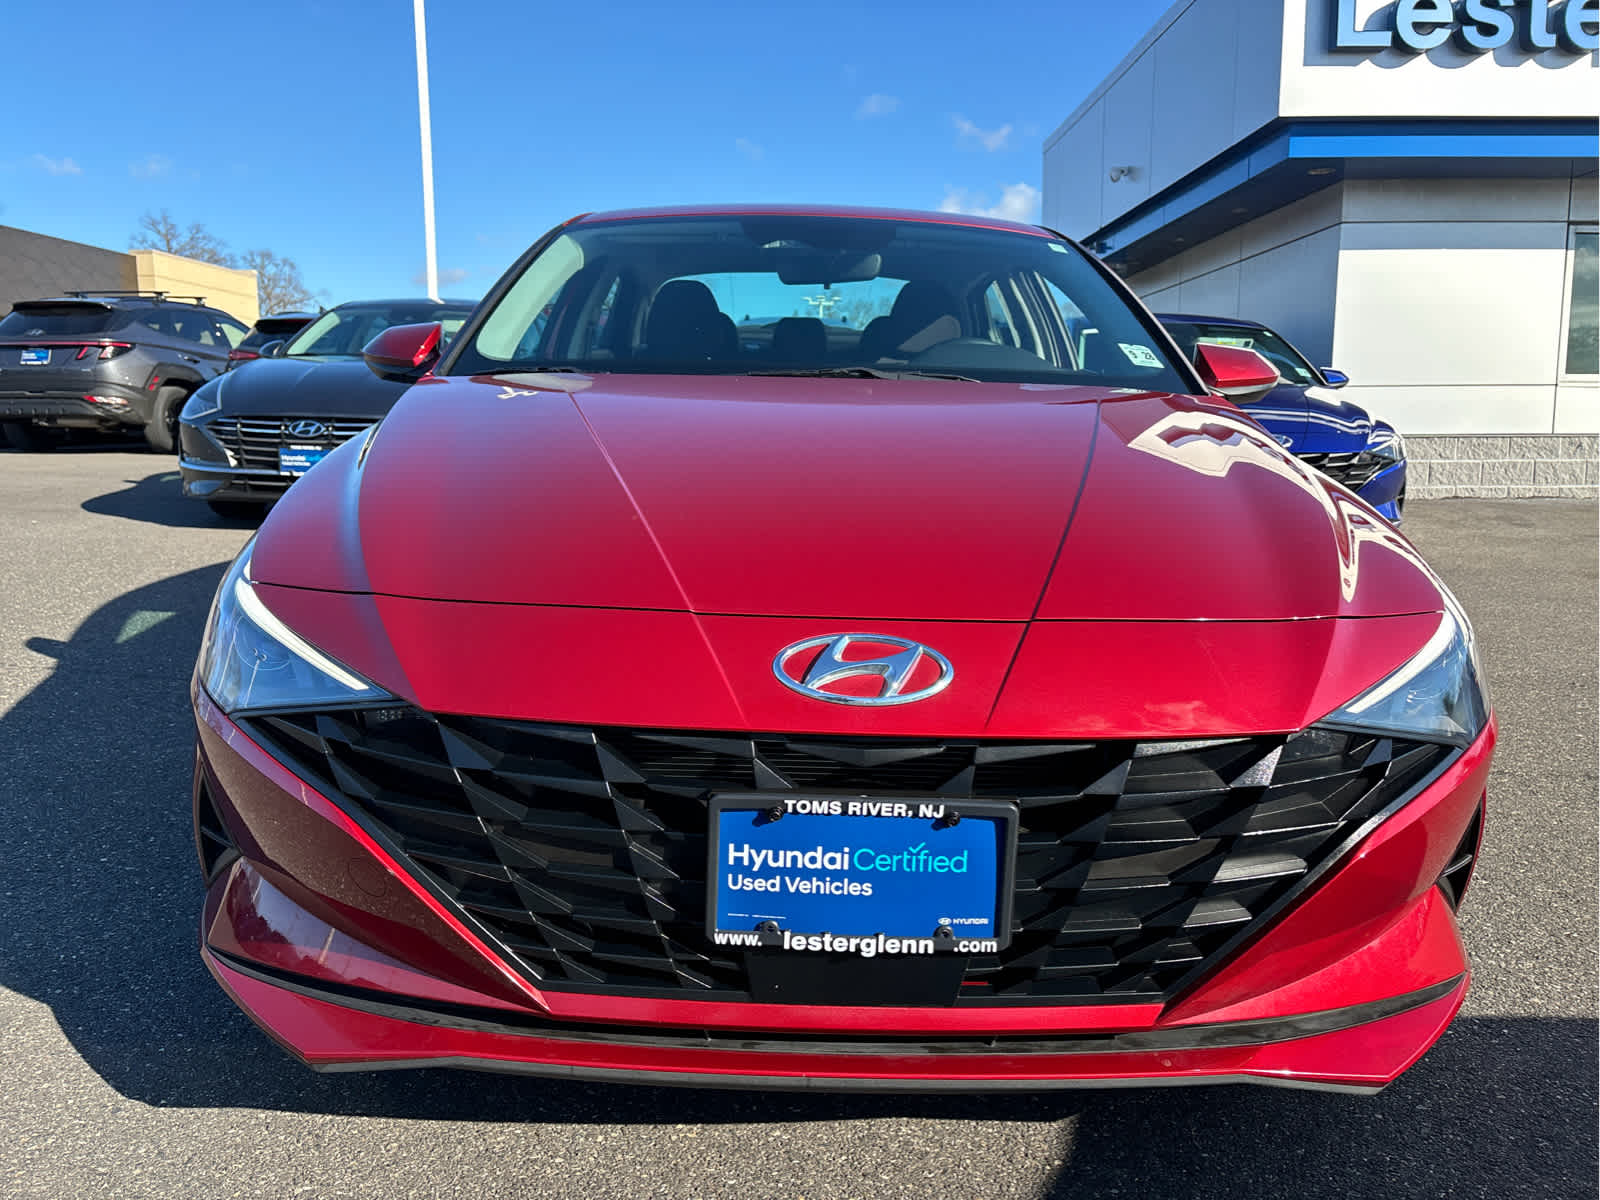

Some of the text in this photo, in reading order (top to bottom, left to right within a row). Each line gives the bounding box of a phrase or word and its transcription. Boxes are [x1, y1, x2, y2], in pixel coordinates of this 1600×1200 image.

[784, 800, 945, 819] TOMS RIVER, NJ
[728, 842, 968, 873] Hyundai Certified
[727, 873, 873, 896] Used Vehicles
[714, 931, 997, 957] www. lesterglenn .com
